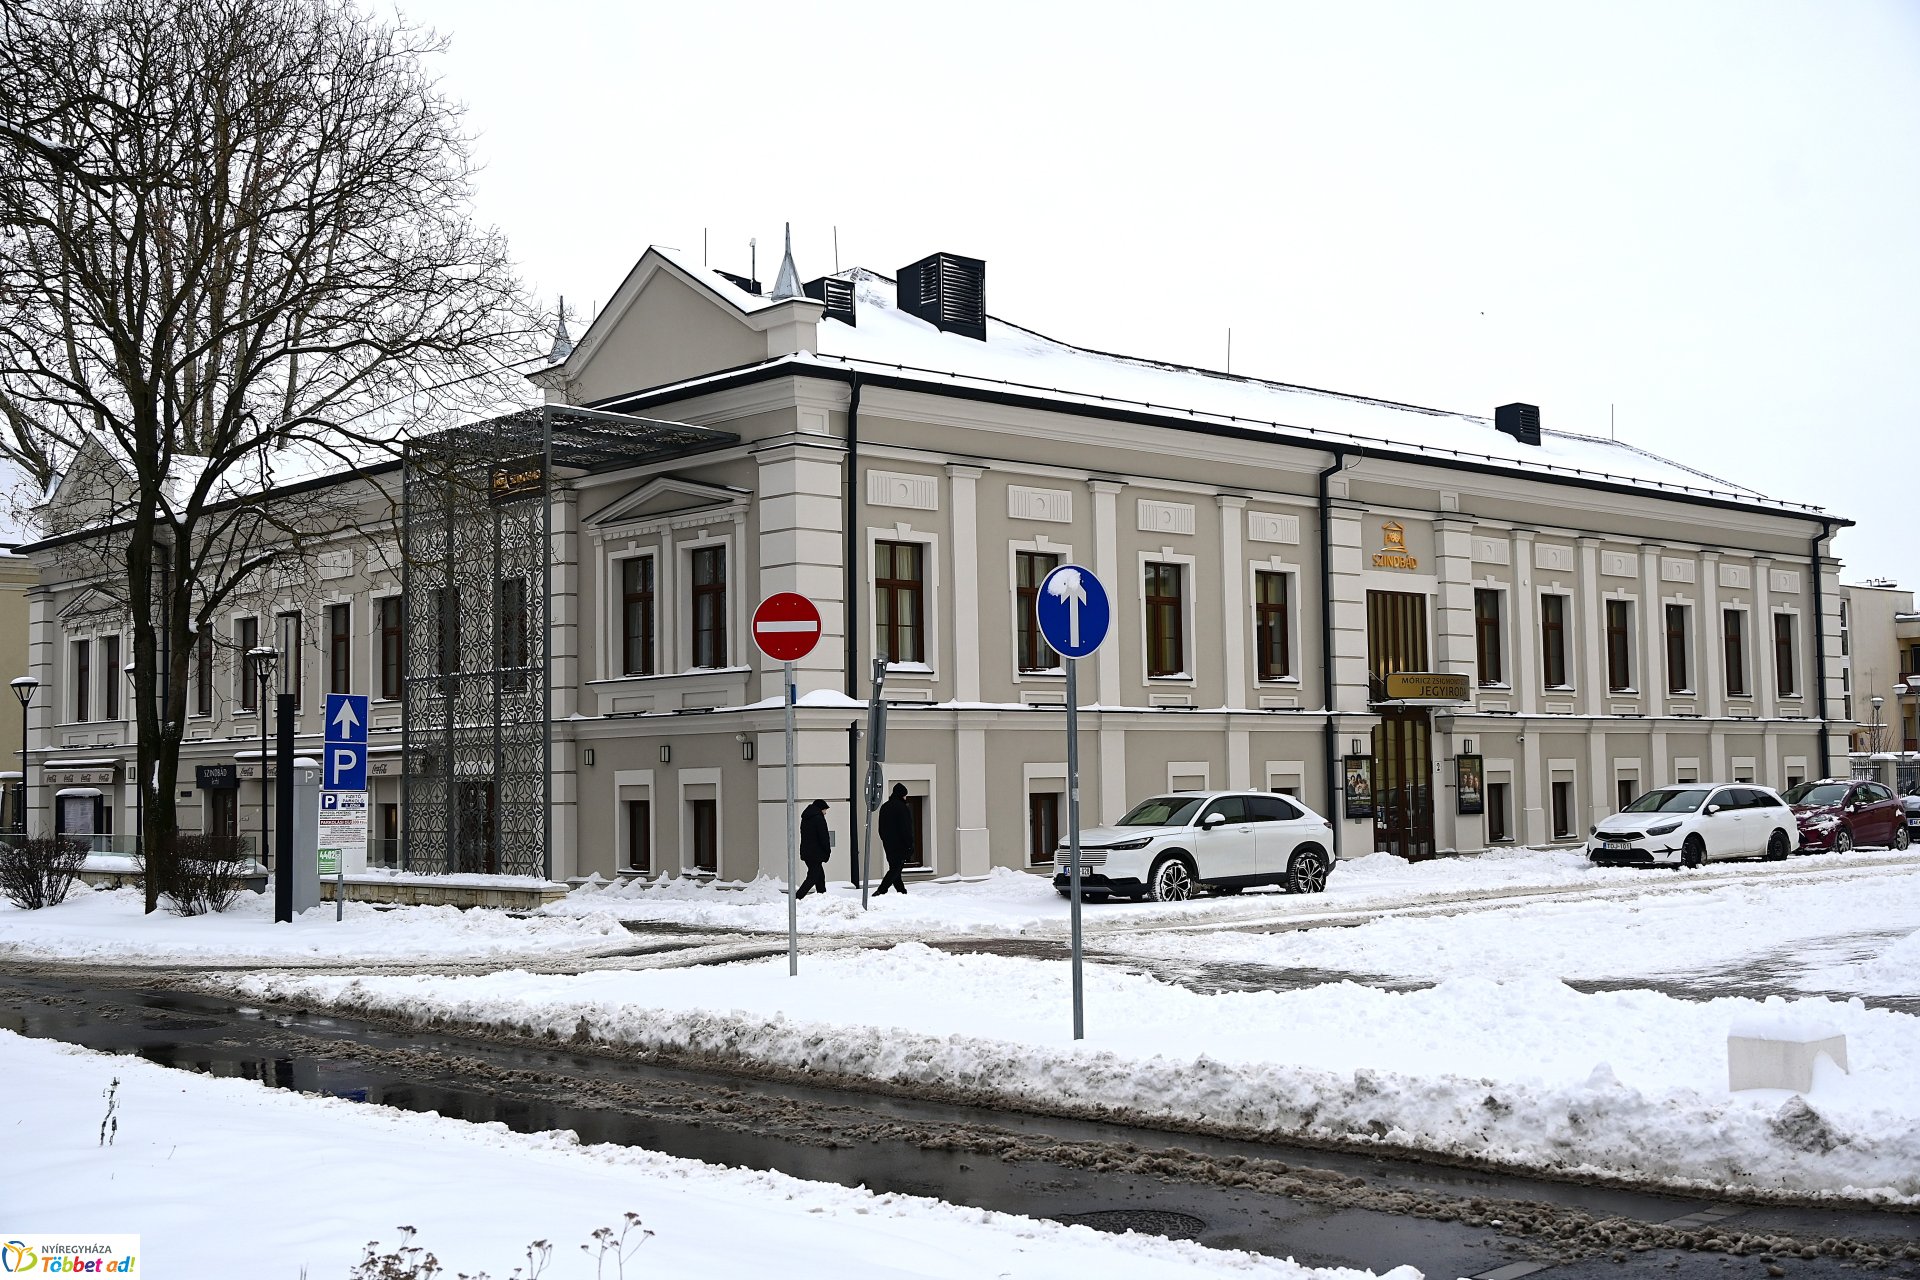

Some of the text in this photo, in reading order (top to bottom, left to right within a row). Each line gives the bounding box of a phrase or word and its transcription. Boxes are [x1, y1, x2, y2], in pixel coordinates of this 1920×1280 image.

[1372, 554, 1417, 569] SZINDBÁD
[1401, 676, 1430, 685] MÓRICZ
[333, 749, 357, 785] P
[305, 770, 314, 783] P
[325, 795, 335, 808] P
